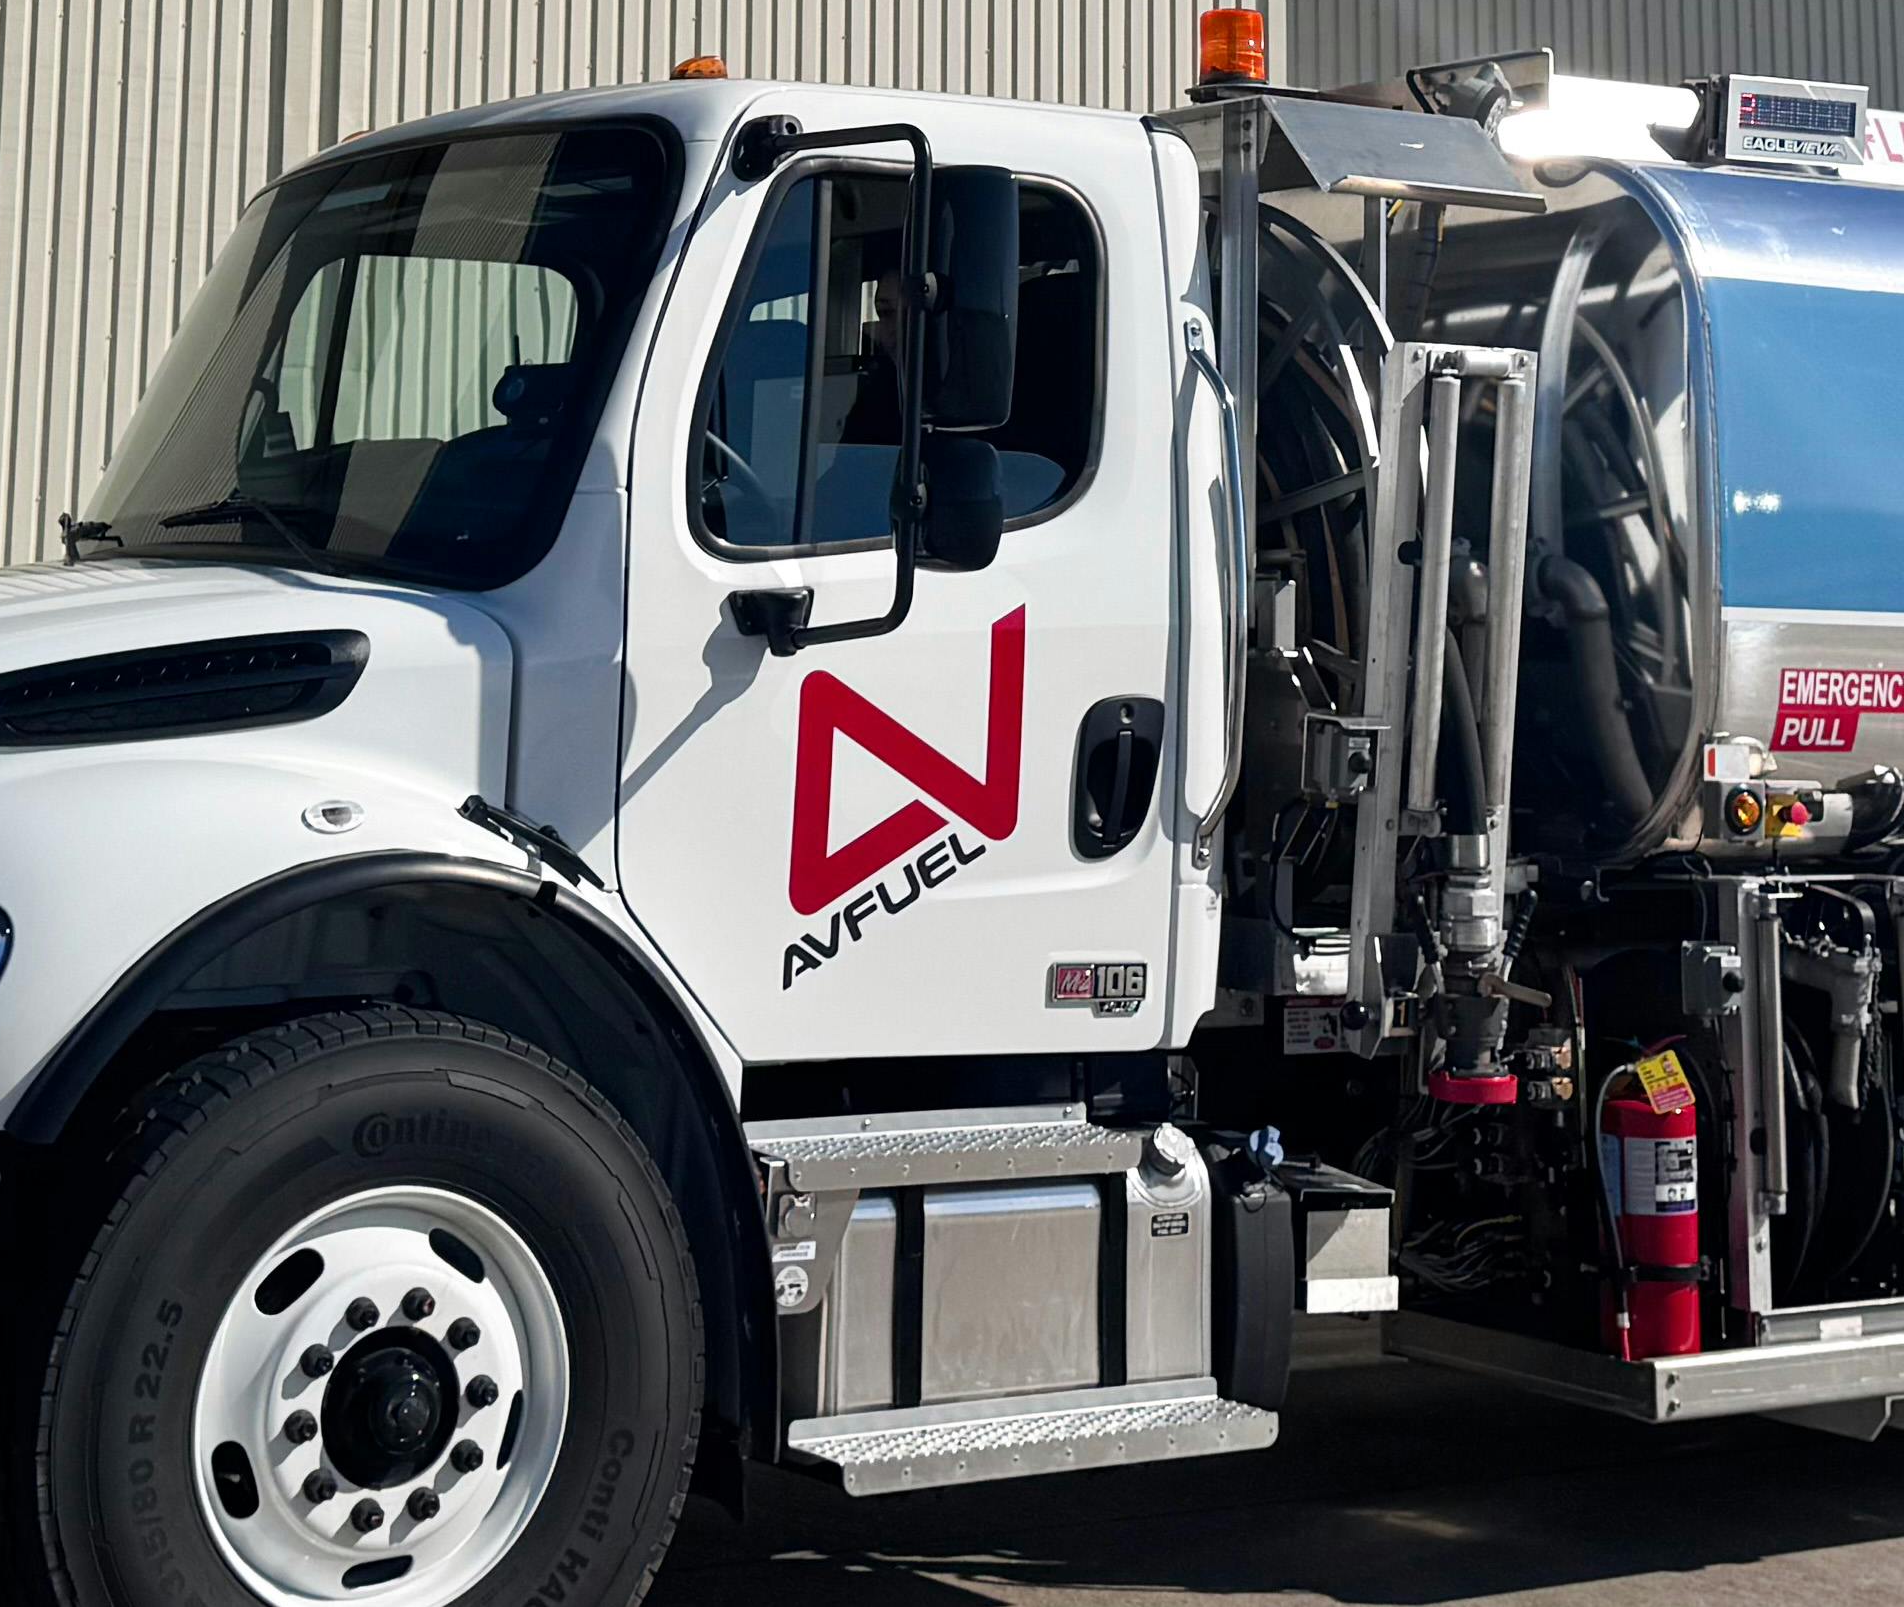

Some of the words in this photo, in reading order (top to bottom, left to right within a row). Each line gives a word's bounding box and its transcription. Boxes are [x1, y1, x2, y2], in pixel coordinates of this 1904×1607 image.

[1742, 136, 1836, 157] EAGLEVIEW
[1780, 718, 1845, 747] PULL
[781, 832, 987, 991] AVFUEL
[1096, 964, 1144, 997] 106
[134, 1297, 184, 1400] 22.5
[127, 1414, 156, 1445] R
[578, 1428, 635, 1543] Conti
